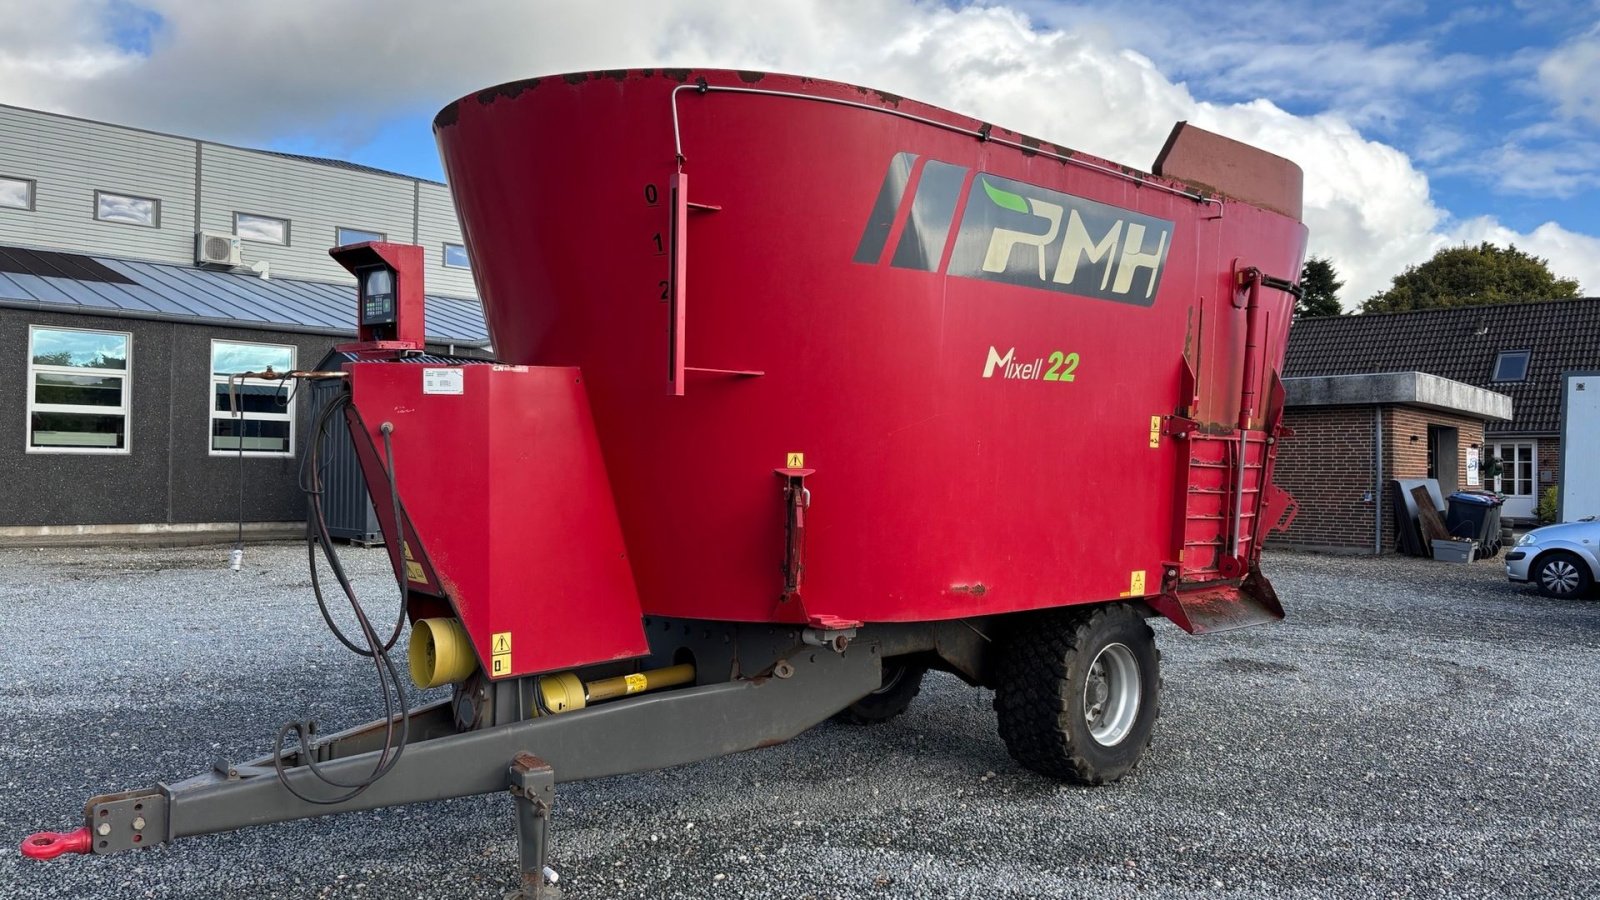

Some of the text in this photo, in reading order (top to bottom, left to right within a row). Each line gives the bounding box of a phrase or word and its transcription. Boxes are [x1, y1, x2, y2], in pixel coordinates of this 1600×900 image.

[644, 184, 657, 204] 0
[653, 233, 663, 252] 1
[981, 196, 1168, 299] RMH
[659, 281, 670, 300] 2
[982, 345, 1080, 382] Mixell 22
